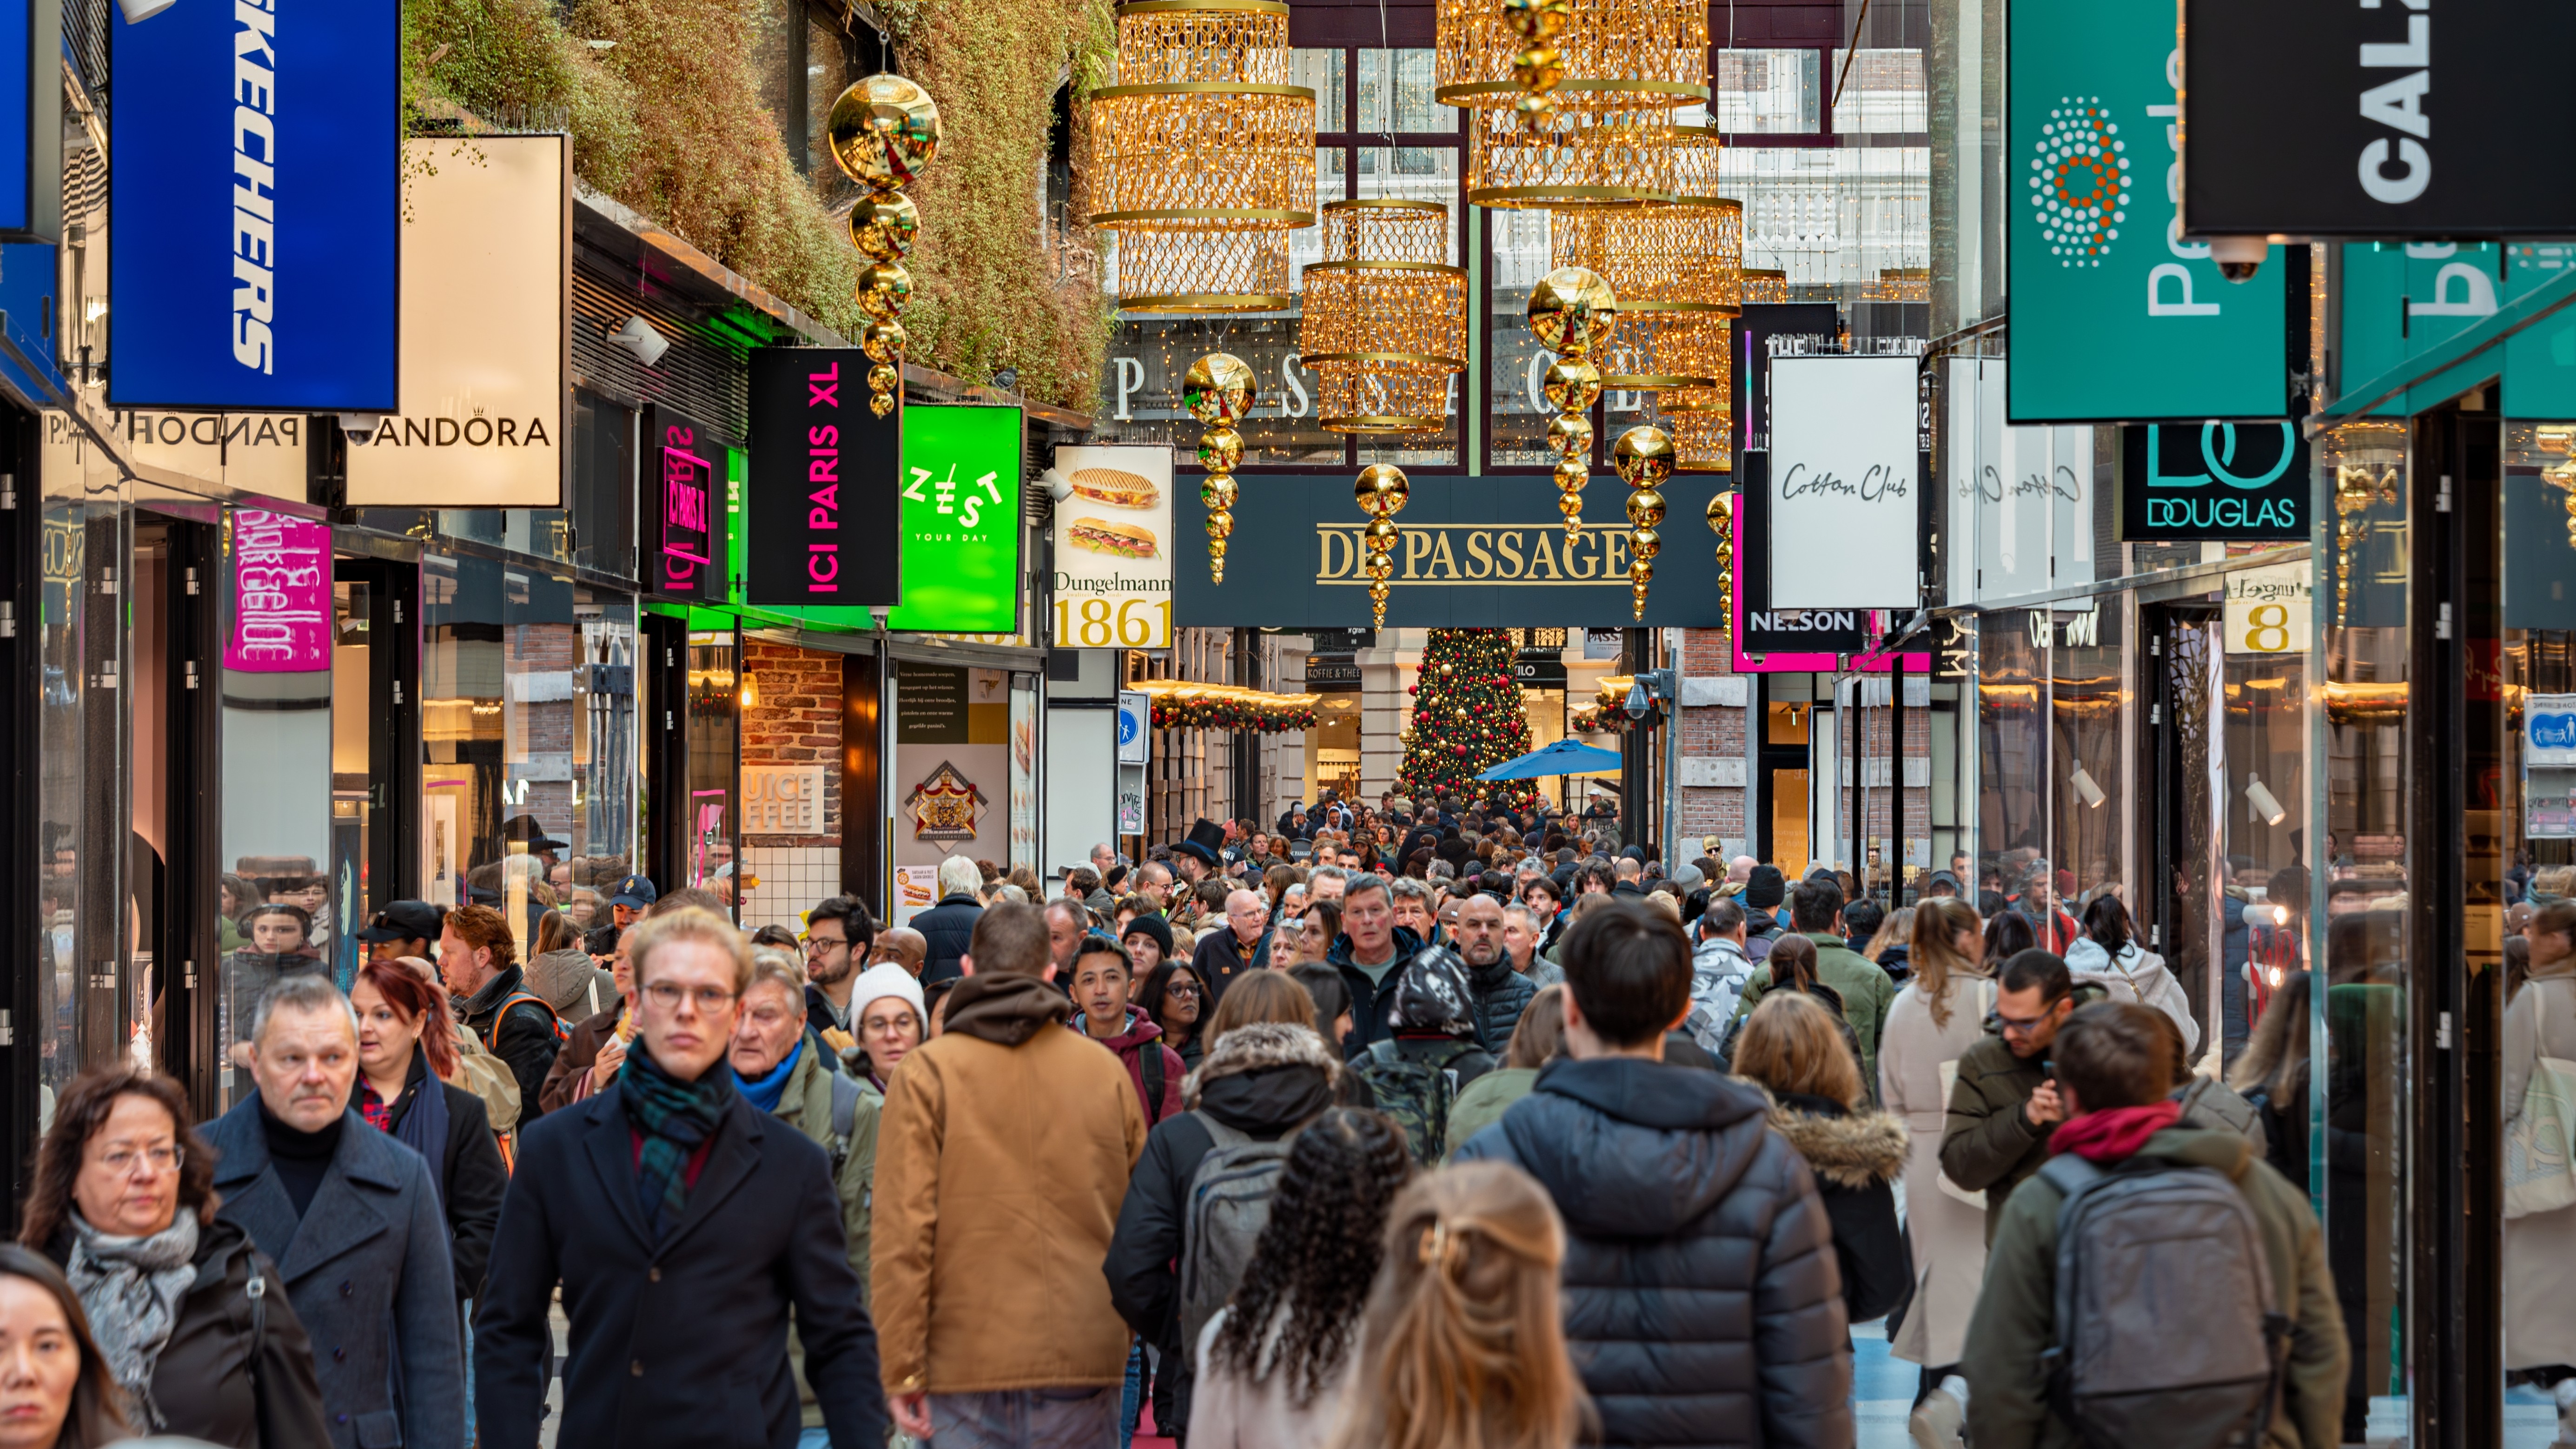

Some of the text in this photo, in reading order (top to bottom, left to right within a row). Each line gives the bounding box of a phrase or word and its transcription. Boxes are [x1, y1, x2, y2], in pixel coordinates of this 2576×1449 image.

[2358, 0, 2432, 204] CAL
[233, 0, 275, 375] KECHERS
[373, 417, 551, 446] ANDORA
[809, 362, 838, 592] ICI PARIS XL
[1782, 463, 1907, 503] Cotton Club
[902, 463, 1003, 528] ZEST
[2147, 498, 2295, 528] DOUGLAS
[915, 533, 951, 542] YOUR
[1401, 530, 1631, 579] PASSAGE
[1054, 571, 1171, 596] Dungelmann
[1054, 598, 1171, 648] 1861
[1587, 633, 1622, 643] PASS
[1308, 668, 1360, 679] KOFFIE & THEE
[743, 773, 812, 801] UICE
[741, 801, 812, 827] FFEE
